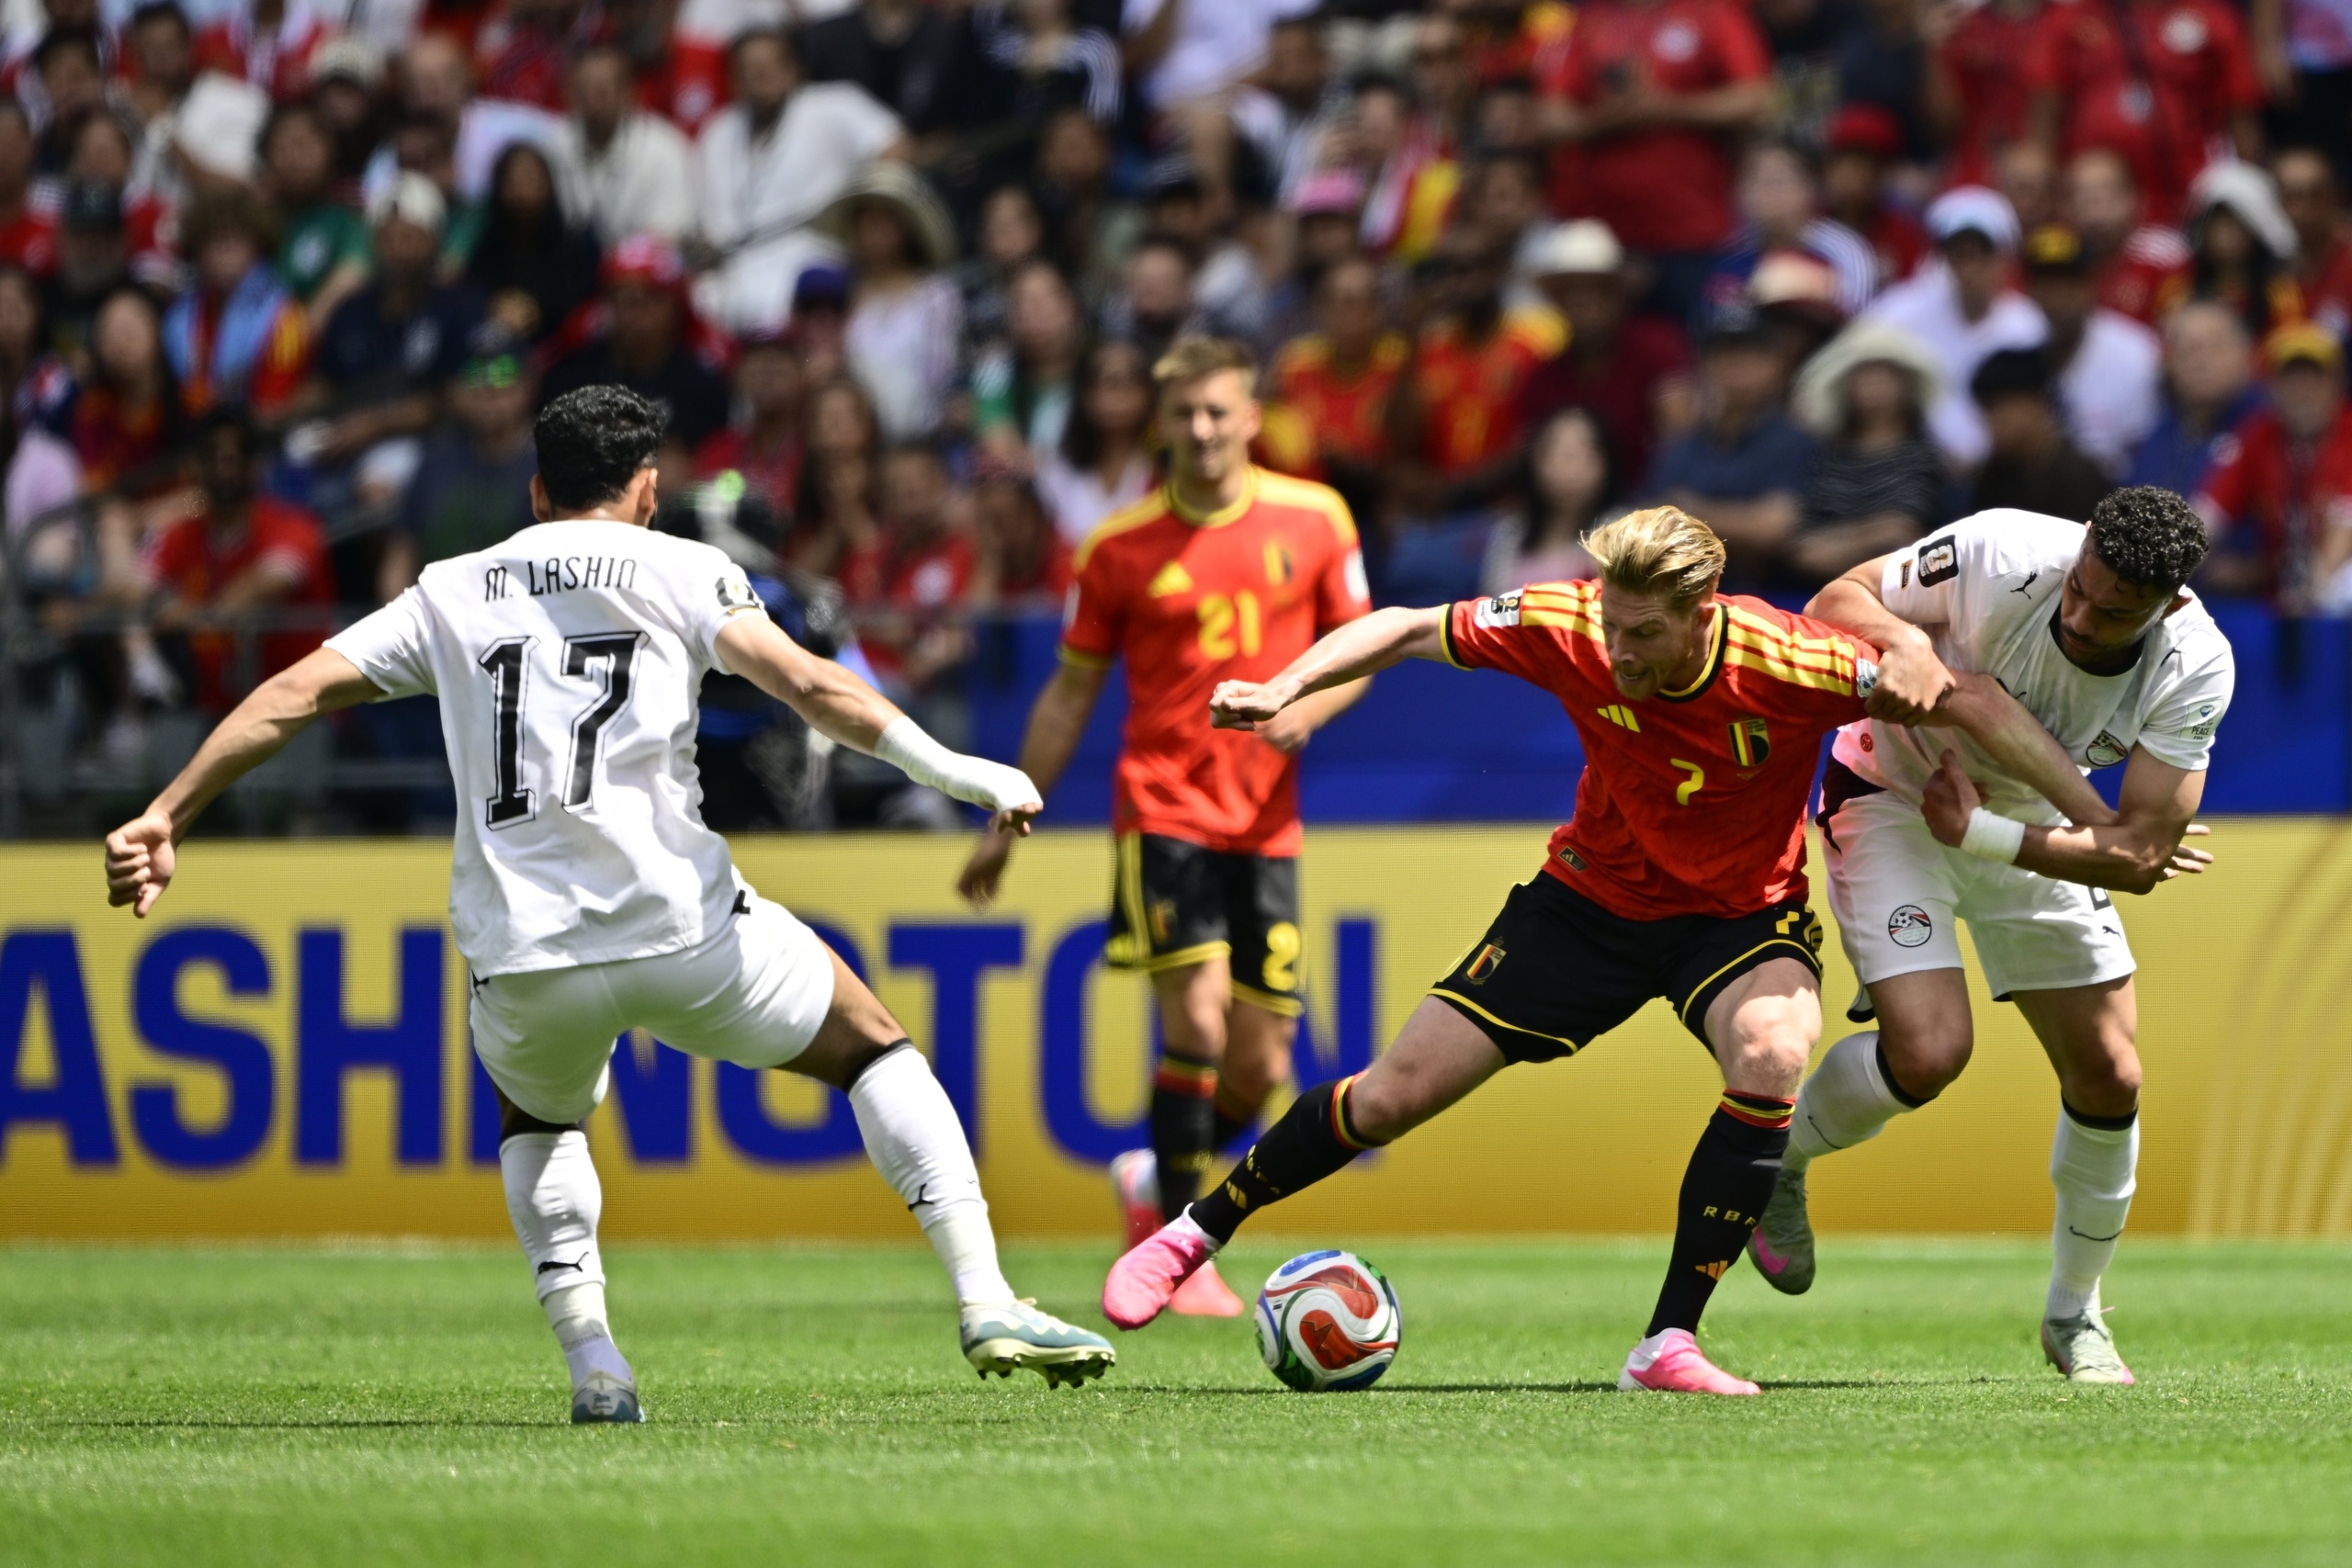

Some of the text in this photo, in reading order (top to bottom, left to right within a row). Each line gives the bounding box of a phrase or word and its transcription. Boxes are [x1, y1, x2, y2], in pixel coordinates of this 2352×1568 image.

[485, 556, 637, 603] M. LASHIN
[1196, 592, 1261, 660] 21
[479, 630, 650, 831] 17
[1669, 758, 1704, 806] 7
[0, 919, 1375, 1172] ASHTON
